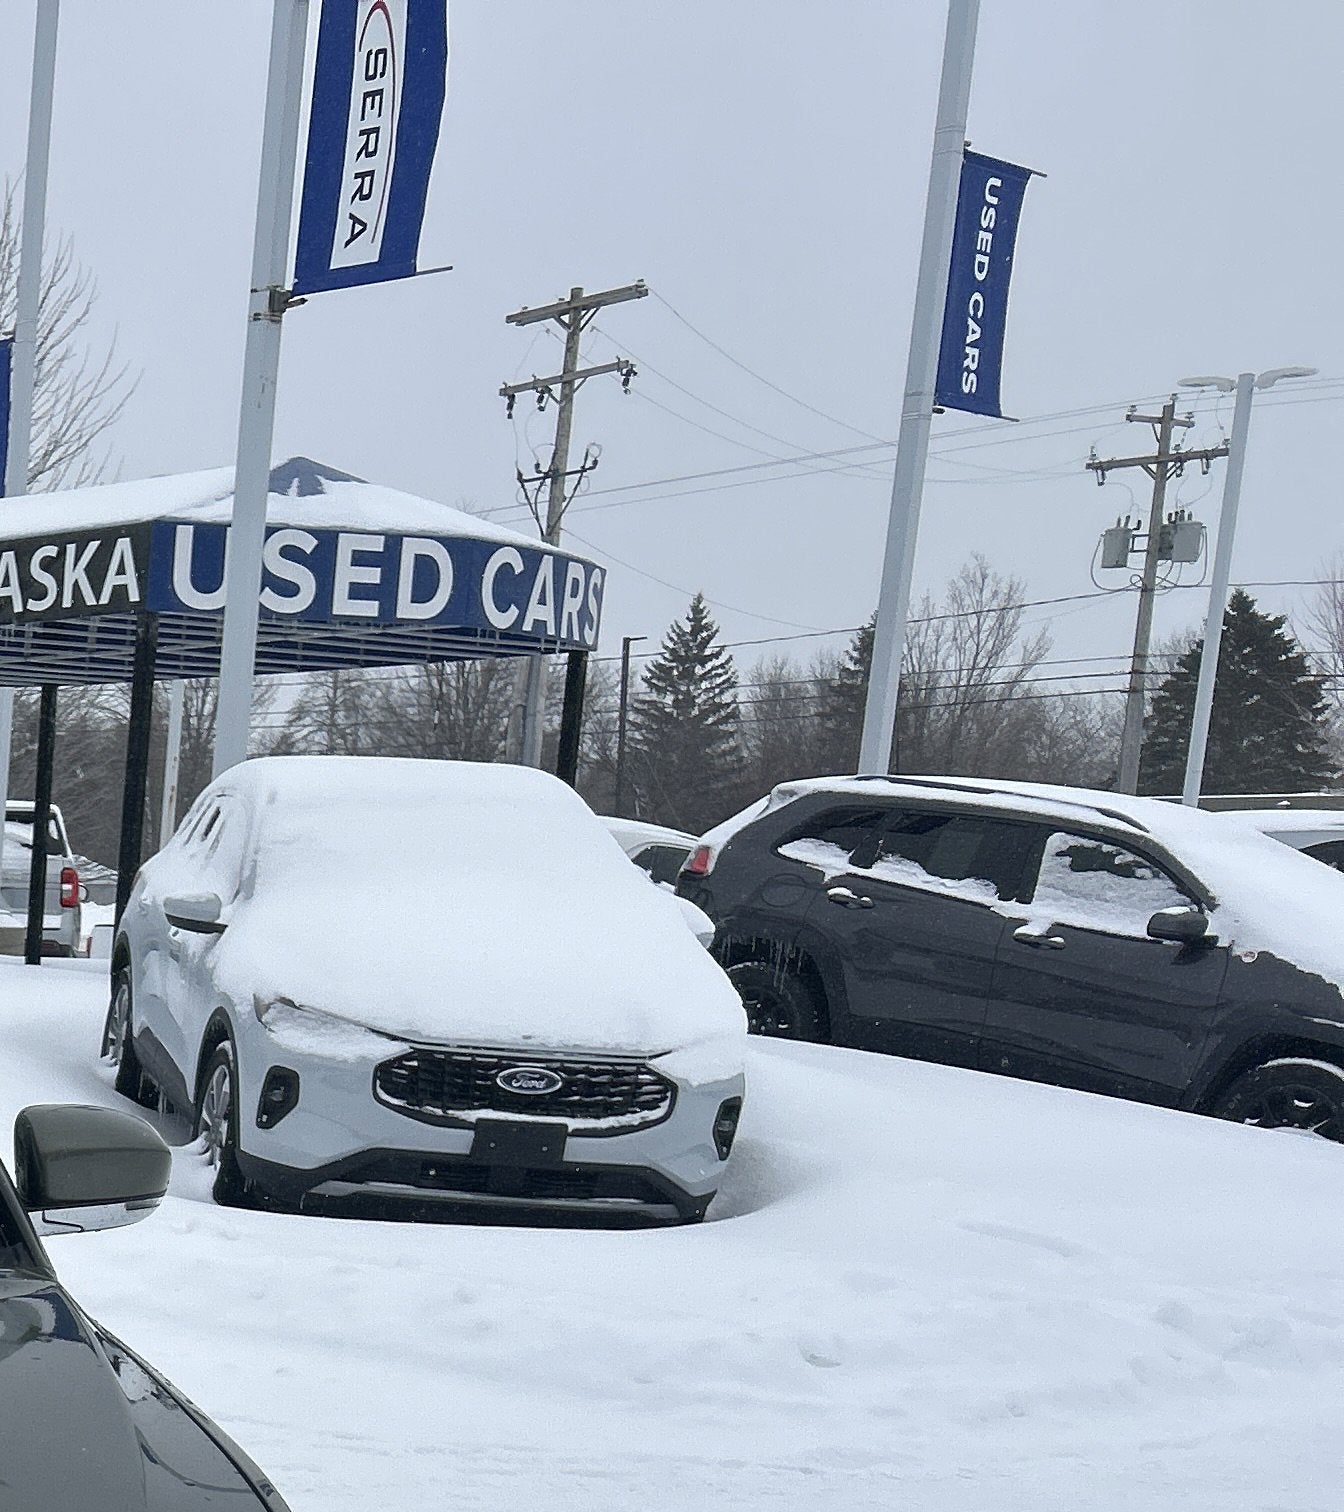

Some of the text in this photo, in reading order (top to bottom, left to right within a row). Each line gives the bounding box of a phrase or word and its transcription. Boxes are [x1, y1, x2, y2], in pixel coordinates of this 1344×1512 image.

[344, 47, 388, 249] SERRA
[961, 177, 1002, 395] USED CARS
[172, 524, 607, 646] USED CARS
[511, 1072, 548, 1089] Ford
